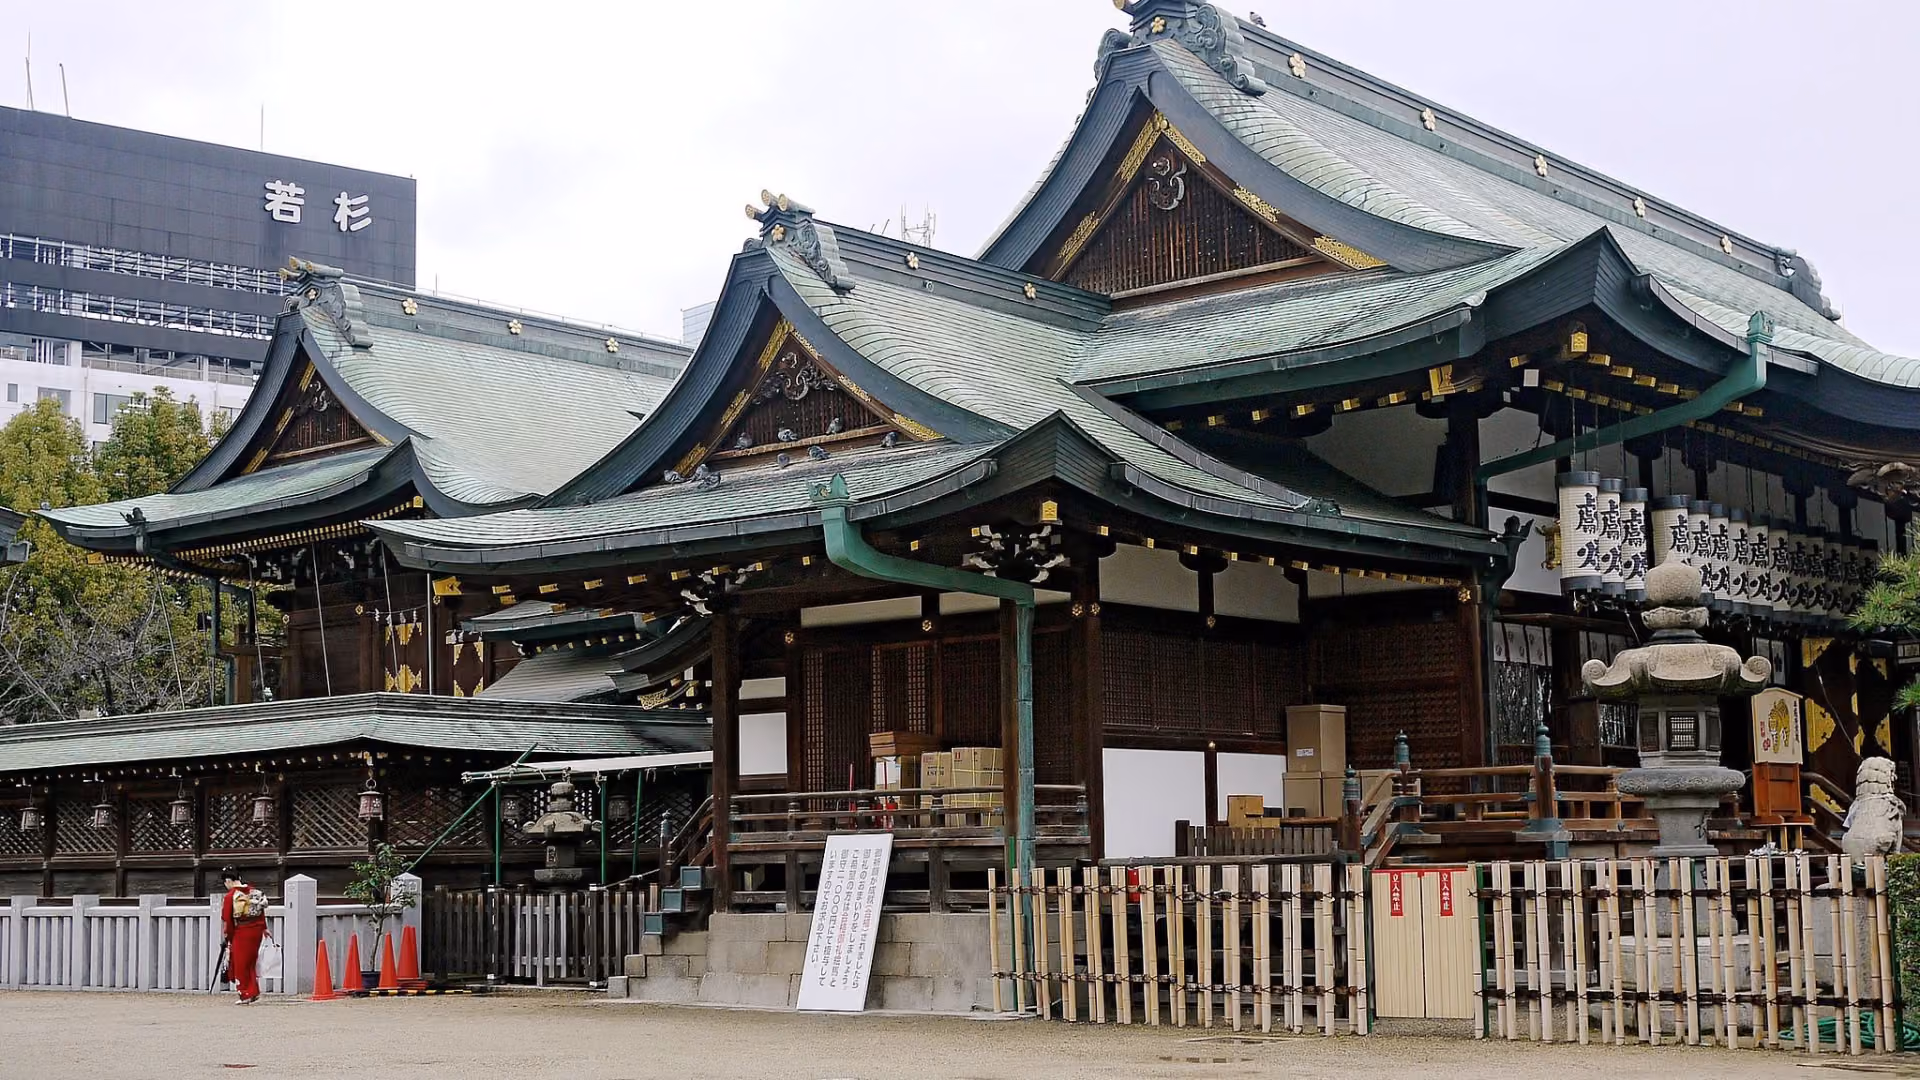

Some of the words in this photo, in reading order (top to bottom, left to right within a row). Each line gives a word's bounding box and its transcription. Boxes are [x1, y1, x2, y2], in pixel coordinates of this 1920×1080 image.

[264, 180, 372, 232] 若杉
[1392, 873, 1400, 911] 立入禁止
[1441, 873, 1450, 911] 立入禁止
